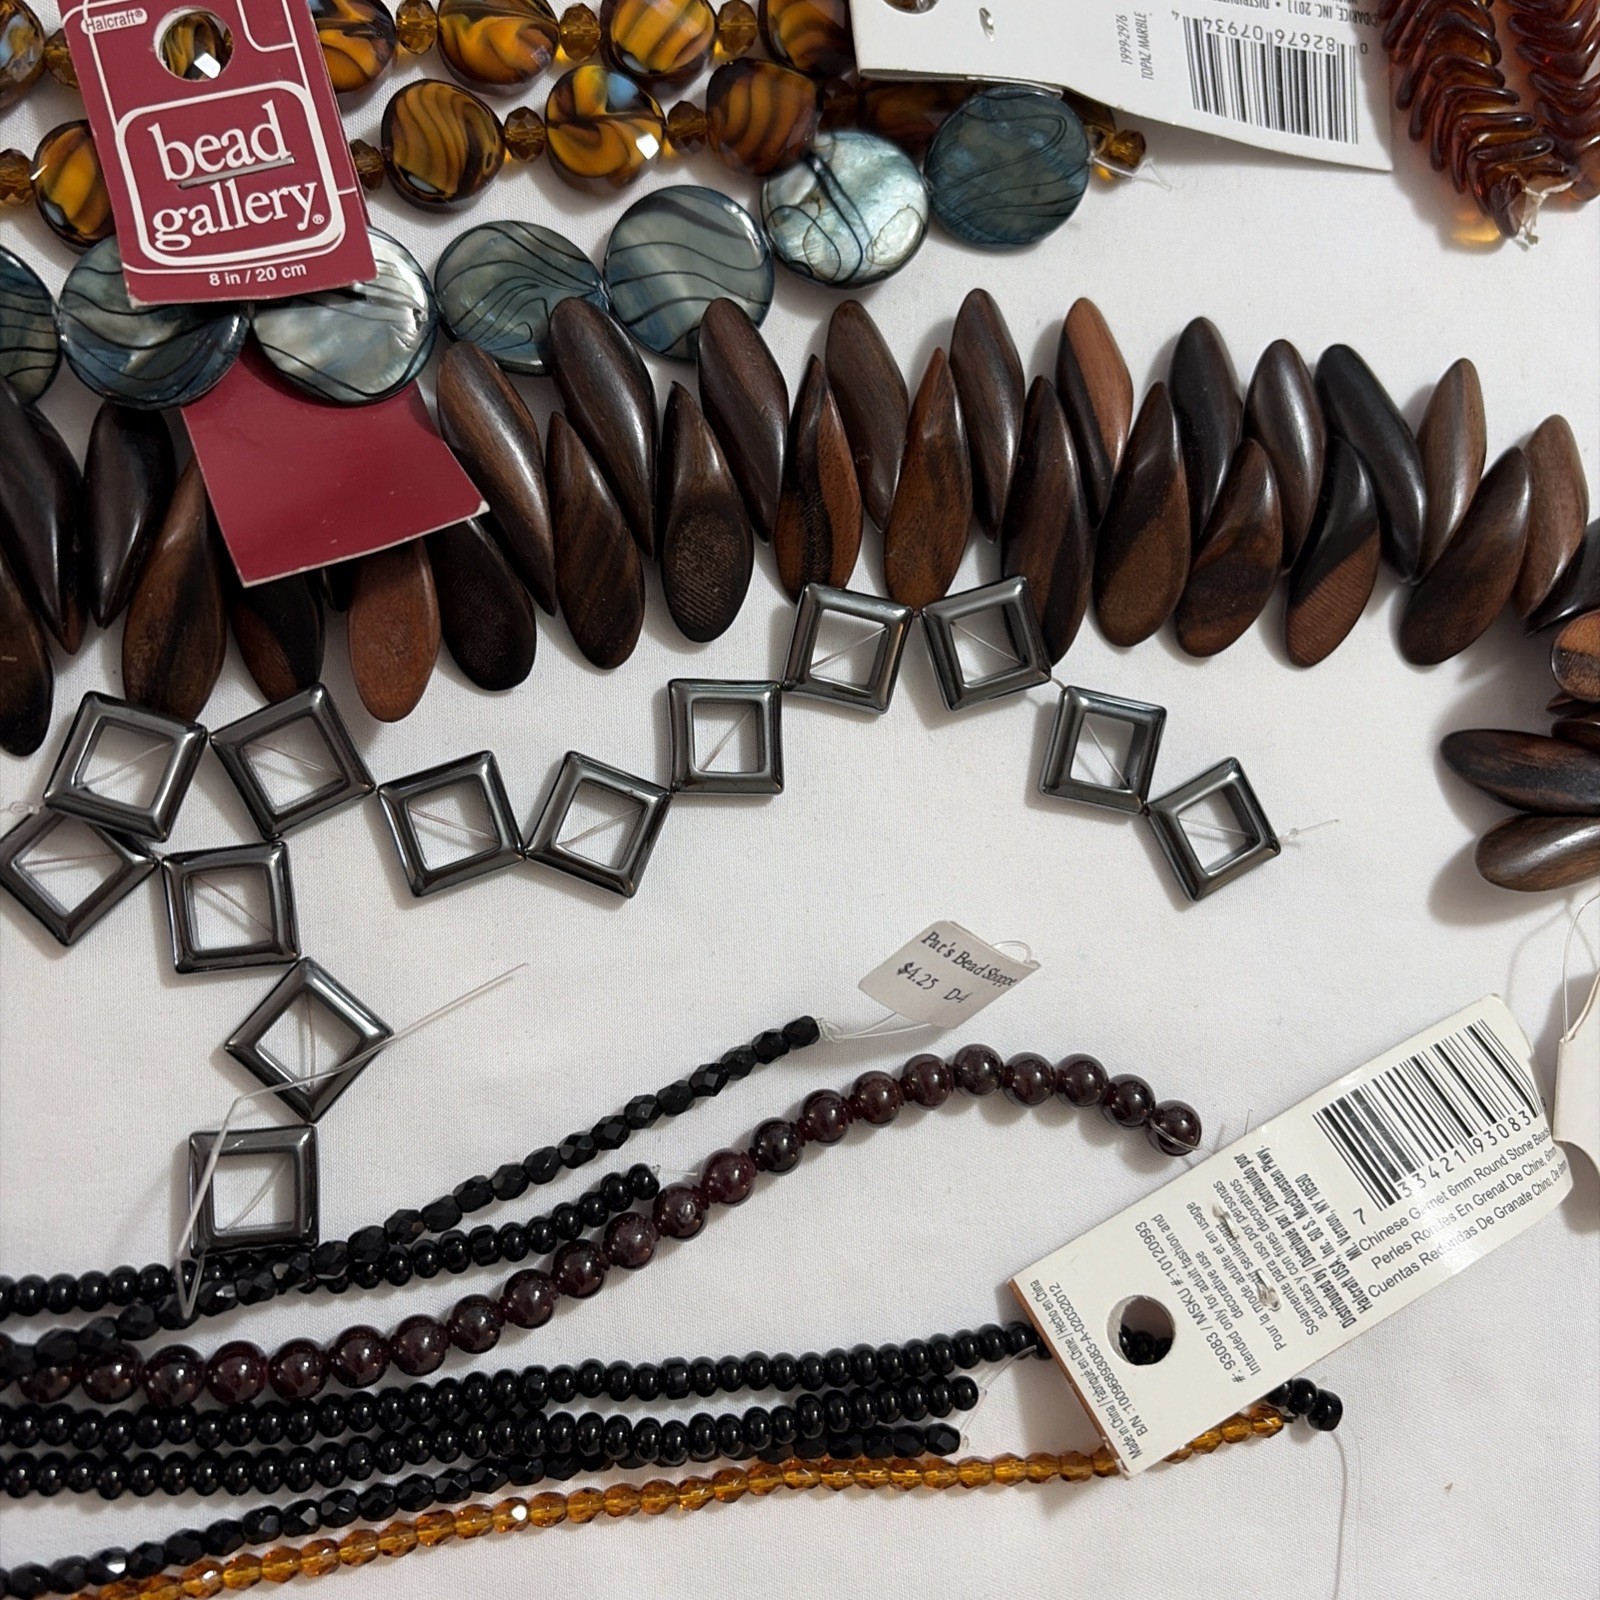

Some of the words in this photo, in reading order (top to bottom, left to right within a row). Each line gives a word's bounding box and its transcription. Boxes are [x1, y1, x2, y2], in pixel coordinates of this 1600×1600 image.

[1287, 0, 1310, 14] 2011
[1118, 14, 1132, 66] 1999-2976
[1136, 12, 1151, 51] MARBLE
[1201, 16, 1263, 40] 07934
[1274, 29, 1335, 51] 82676
[1141, 50, 1154, 81] TOPAZ
[147, 99, 292, 181] bead
[209, 273, 220, 286] 8
[224, 270, 241, 285] in
[255, 267, 277, 282] 20
[281, 263, 307, 277] cm
[897, 962, 939, 990] $4.25
[952, 951, 990, 976] Bead
[1233, 1152, 1253, 1168] por
[1254, 1144, 1277, 1172] Pkwy.
[1352, 1208, 1366, 1225] 7
[1397, 1149, 1465, 1198] 33421
[1472, 1110, 1530, 1152] 93083
[1269, 1169, 1308, 1219] MacQuesten
[1295, 1173, 1319, 1200] 10550
[1358, 1216, 1409, 1251] Chinese
[1446, 1175, 1475, 1196] 6mm
[1473, 1154, 1508, 1180] Round
[1506, 1139, 1534, 1160] Stone
[1212, 1180, 1246, 1223] personas
[1229, 1178, 1269, 1232] decorativos
[1312, 1198, 1329, 1213] NY
[1371, 1239, 1412, 1269] Perles
[1454, 1201, 1473, 1217] En
[1472, 1178, 1509, 1206] Grenat
[1505, 1170, 1523, 1185] De
[1521, 1156, 1547, 1176] Chine,
[1151, 1213, 1170, 1233] and
[1186, 1201, 1209, 1230] usage
[1274, 1212, 1293, 1229] par
[1301, 1216, 1316, 1230] S.
[1324, 1210, 1351, 1245] Vernon,
[1205, 1230, 1217, 1243] en
[1240, 1223, 1259, 1241] por
[1264, 1231, 1285, 1257] fines
[1307, 1226, 1323, 1241] 60
[1367, 1261, 1420, 1297] Cuentas
[1475, 1214, 1494, 1230] De
[1492, 1190, 1533, 1219] Granate
[1165, 1232, 1192, 1268] fashion
[1195, 1250, 1211, 1269] use
[1212, 1243, 1225, 1254] et
[1252, 1240, 1270, 1260] uso
[1281, 1227, 1315, 1267] Distribué
[1317, 1238, 1335, 1258] Inc.
[1343, 1242, 1362, 1261] Mt.
[1220, 1254, 1244, 1285] adulte
[1265, 1259, 1287, 1282] para
[1281, 1255, 1298, 1275] con
[1311, 1267, 1327, 1283] by
[1327, 1254, 1350, 1280] USA,
[1028, 1279, 1047, 1302] China
[1186, 1267, 1209, 1293] adult
[1294, 1275, 1306, 1284] y
[1041, 1299, 1053, 1311] en
[1177, 1287, 1207, 1324] MSKU
[1203, 1293, 1218, 1309] for
[1206, 1269, 1243, 1319] decorative
[1239, 1284, 1263, 1313] mode
[1298, 1283, 1327, 1320] adultas
[1315, 1278, 1357, 1328] Distributed
[1340, 1276, 1372, 1313] Halcraft
[1213, 1307, 1233, 1331] only
[1258, 1312, 1270, 1325] la
[1279, 1282, 1318, 1335] Solamente
[1046, 1309, 1067, 1335] Hecho
[1063, 1337, 1082, 1360] Chine
[1264, 1324, 1286, 1350] Pour
[1076, 1357, 1089, 1369] en
[1205, 1331, 1236, 1370] 93083
[1226, 1330, 1261, 1375] Intended
[1080, 1367, 1109, 1402] Fabriqué
[1104, 1404, 1124, 1428] China
[1129, 1414, 1147, 1436] B/N
[1117, 1425, 1129, 1437] in
[1122, 1434, 1142, 1459] Made
